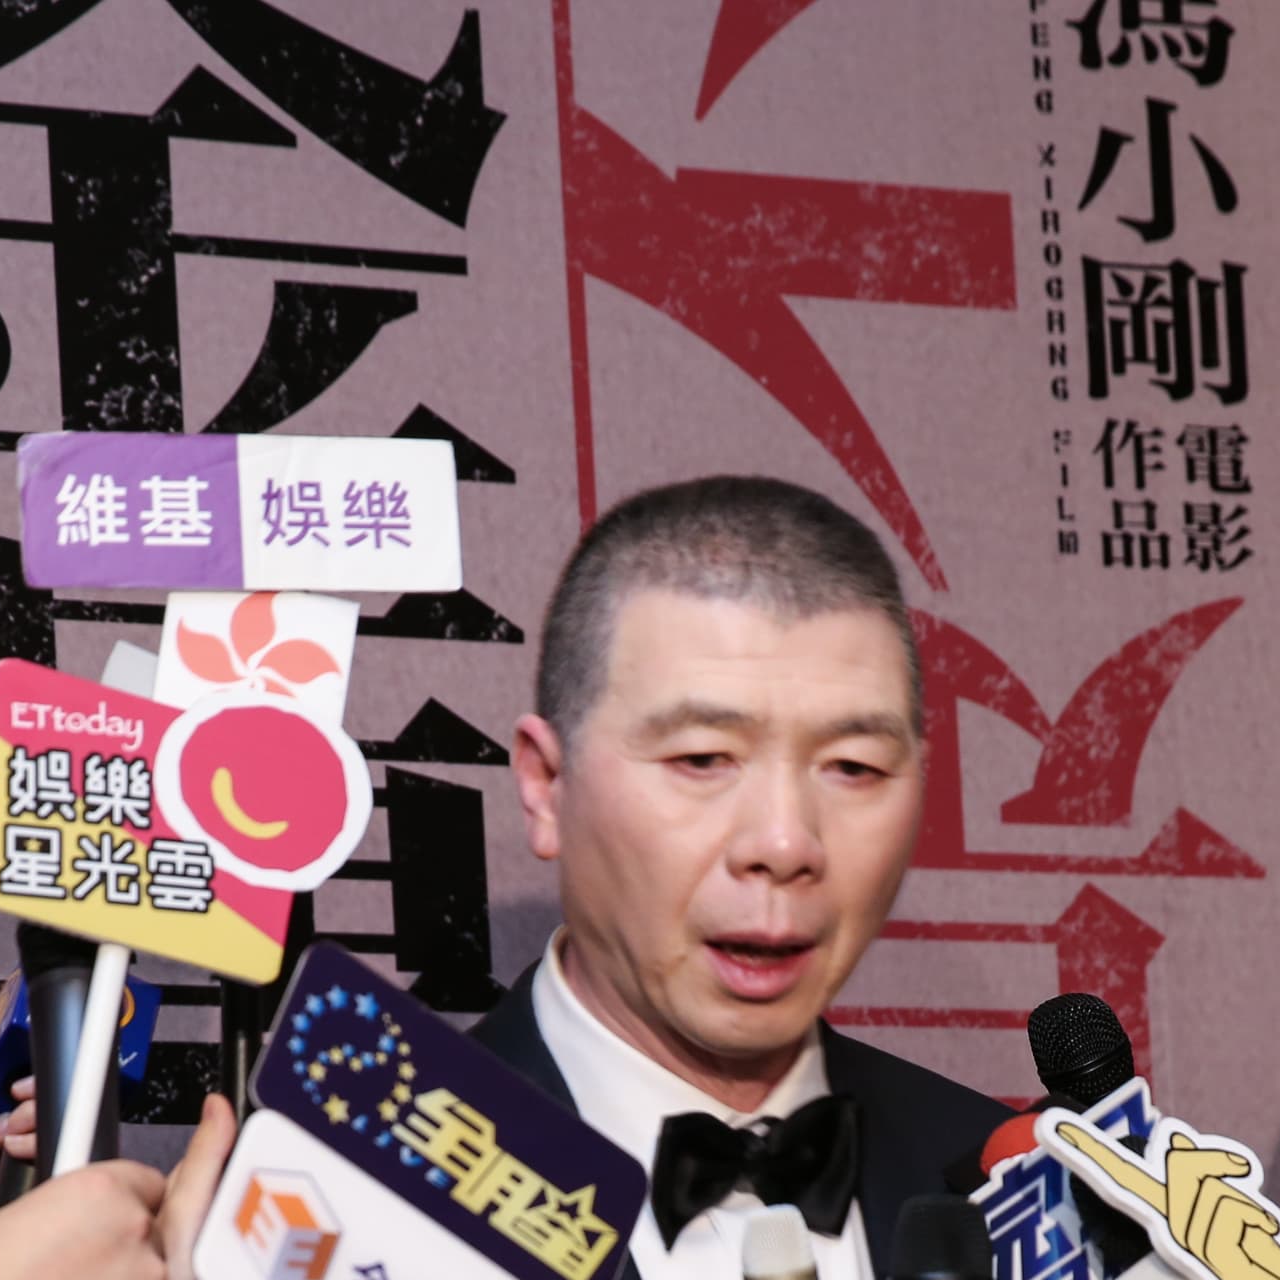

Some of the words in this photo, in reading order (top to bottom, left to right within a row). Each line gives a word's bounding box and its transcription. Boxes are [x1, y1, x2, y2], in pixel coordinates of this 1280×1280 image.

[1092, 418, 1171, 573] 作品
[1175, 422, 1255, 575] 電影
[9, 700, 146, 752] ETtoday
[6, 747, 153, 830] 娛樂
